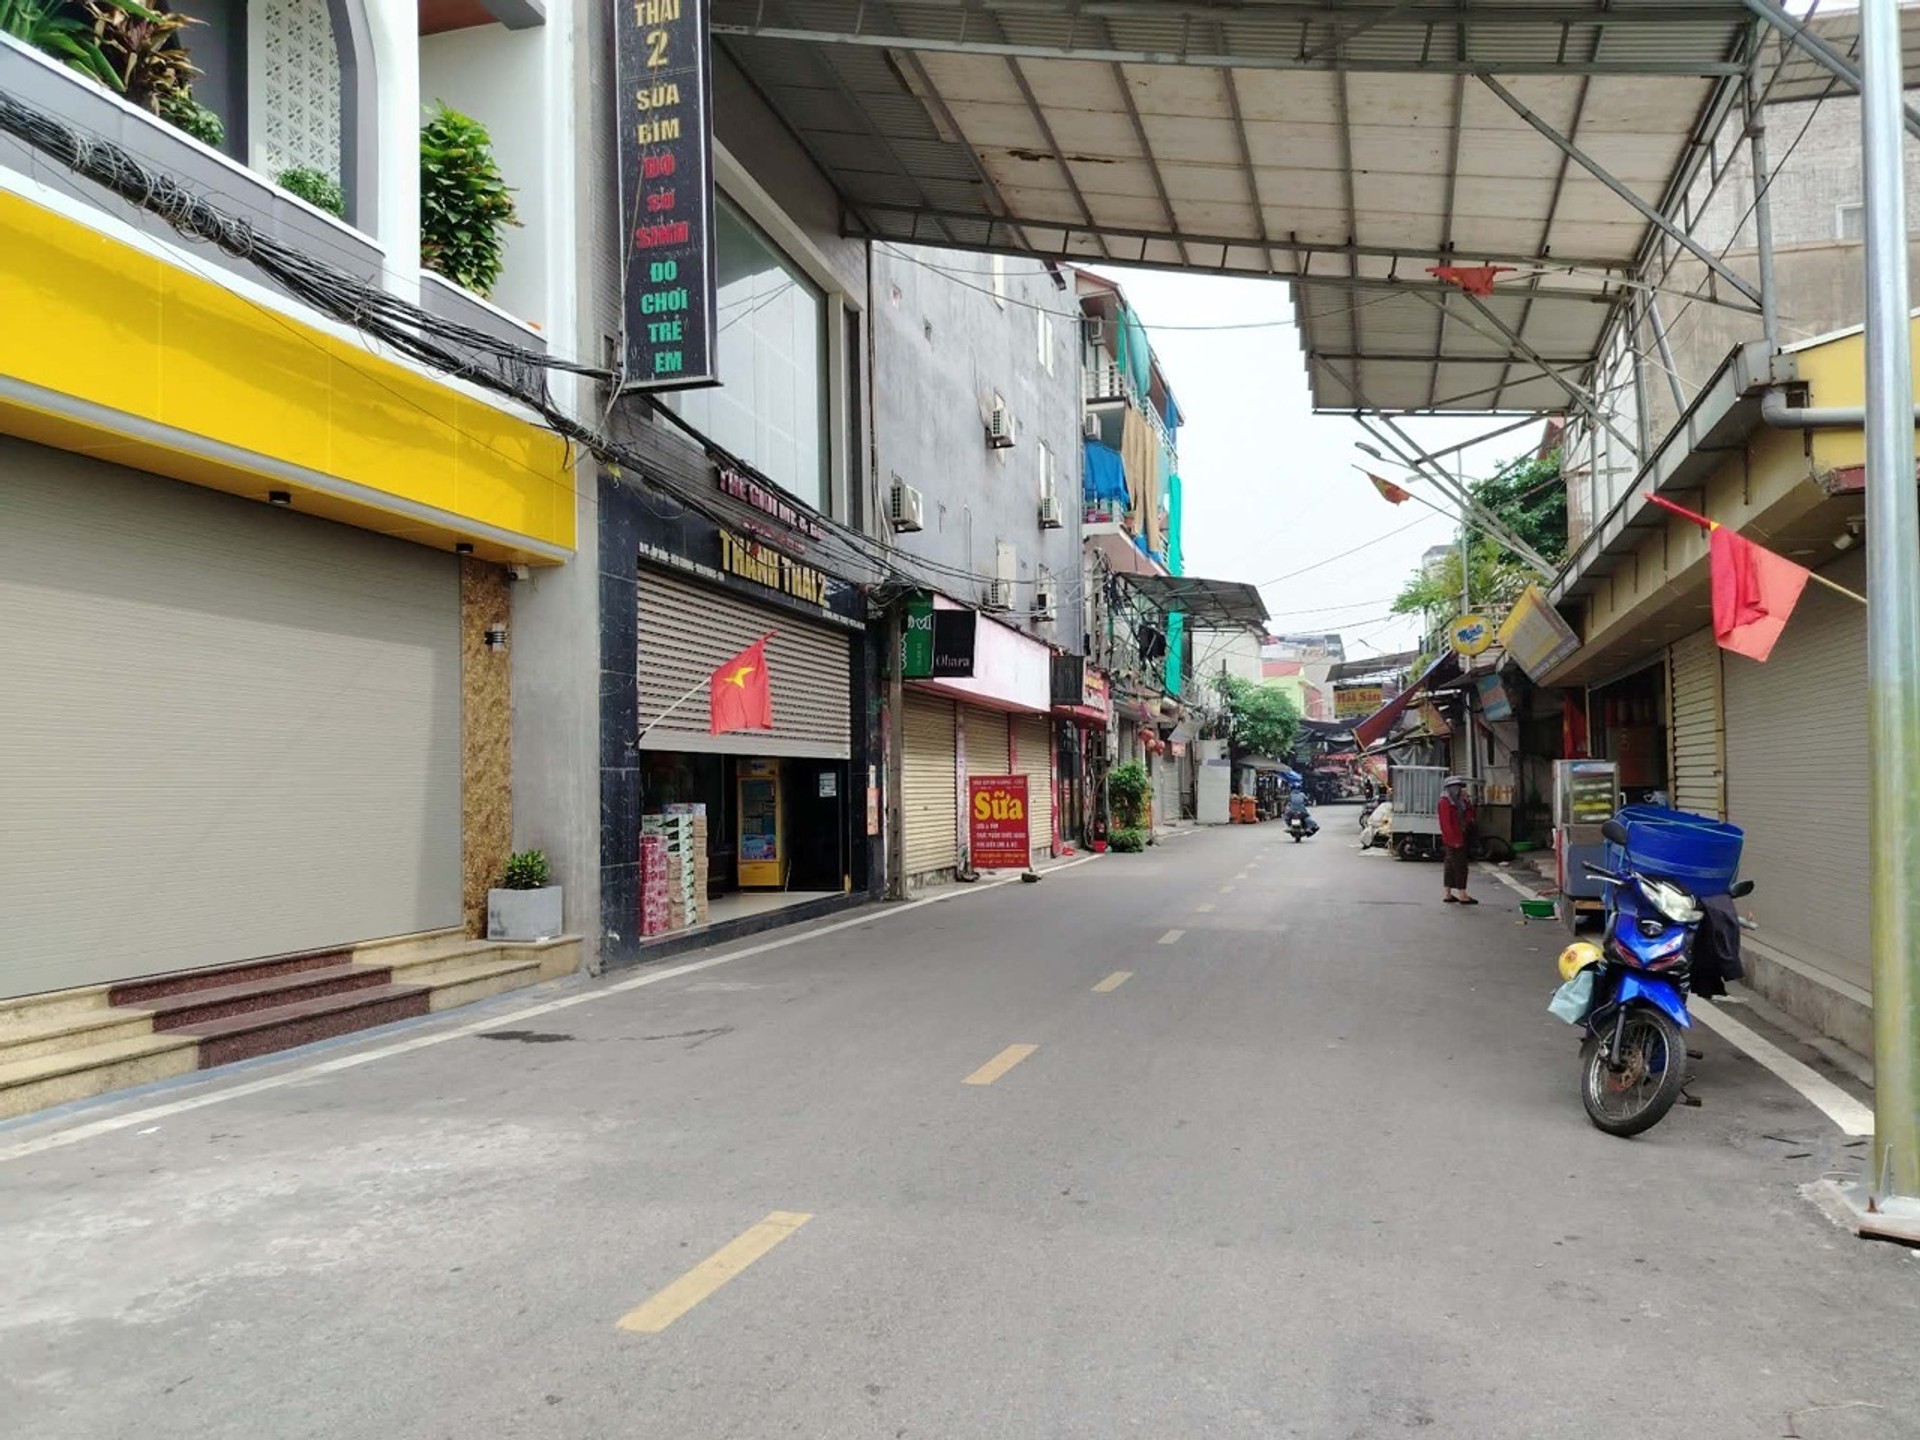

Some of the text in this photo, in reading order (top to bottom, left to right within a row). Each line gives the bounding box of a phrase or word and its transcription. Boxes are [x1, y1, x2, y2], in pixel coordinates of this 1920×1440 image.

[646, 31, 668, 67] 2
[654, 351, 682, 373] EM
[974, 790, 1024, 820] Sữa
